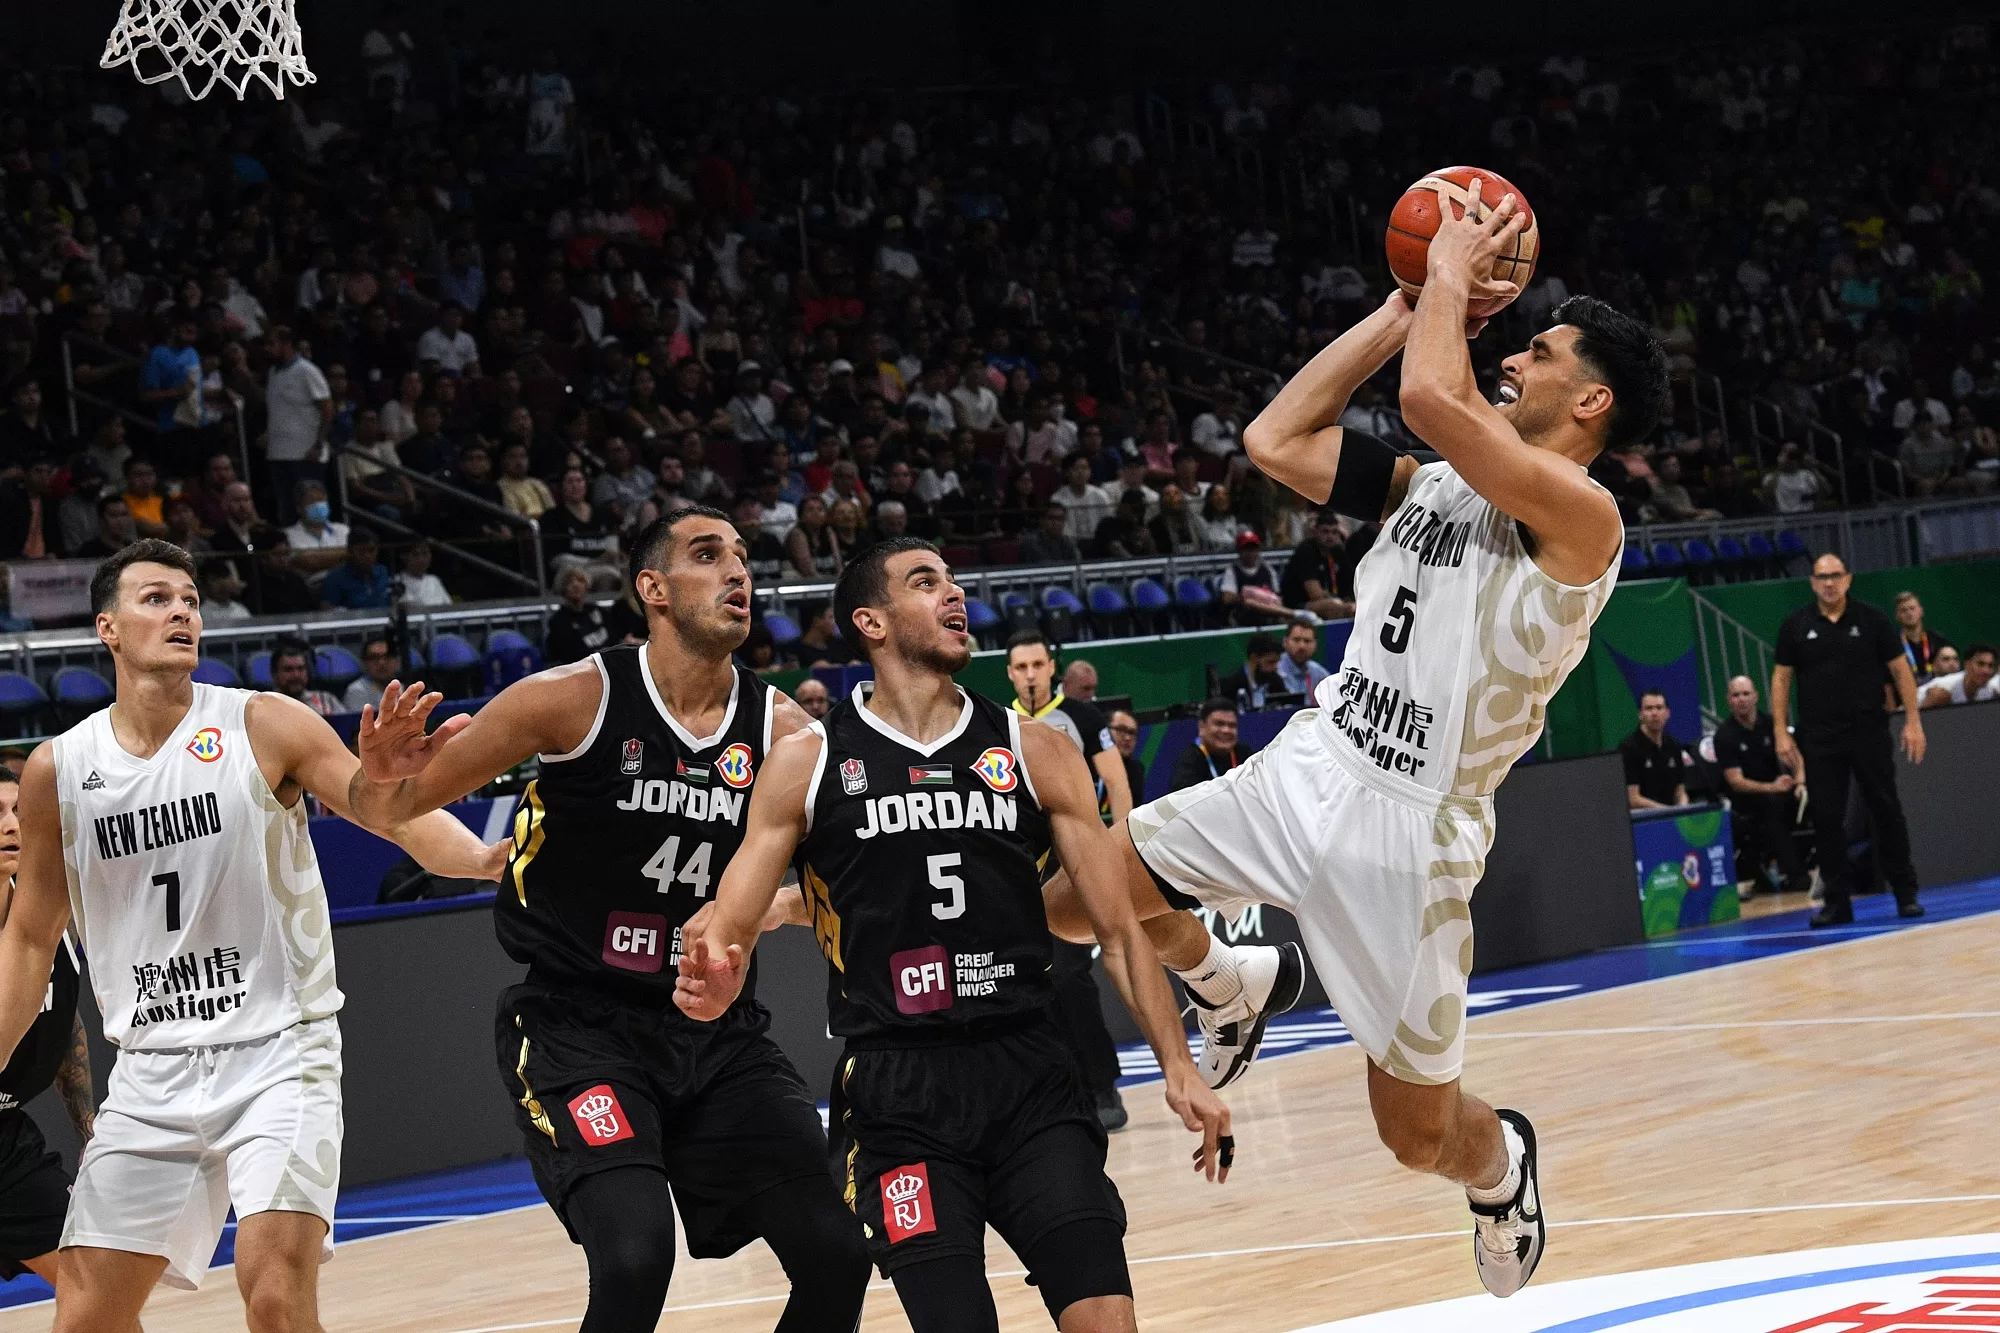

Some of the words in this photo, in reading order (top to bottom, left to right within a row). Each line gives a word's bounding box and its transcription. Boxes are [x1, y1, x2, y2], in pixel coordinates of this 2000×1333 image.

[1380, 585, 1417, 654] 5
[622, 760, 640, 771] JBF
[82, 780, 107, 791] PEAK
[847, 778, 866, 792] JBF
[94, 811, 139, 860] NEW
[138, 792, 222, 851] ZEALAND
[855, 791, 1018, 840] JORDAN
[641, 835, 713, 897] 44
[152, 871, 181, 932] 7
[926, 852, 967, 920] 5
[612, 926, 658, 956] CFI
[954, 951, 994, 968] CREDIT
[956, 963, 1016, 982] FINANCIER
[900, 962, 946, 997] CFI
[957, 980, 999, 997] INVEST
[131, 991, 247, 1028] Austiger
[590, 1113, 619, 1138] RJ
[893, 1199, 921, 1230] RJ
